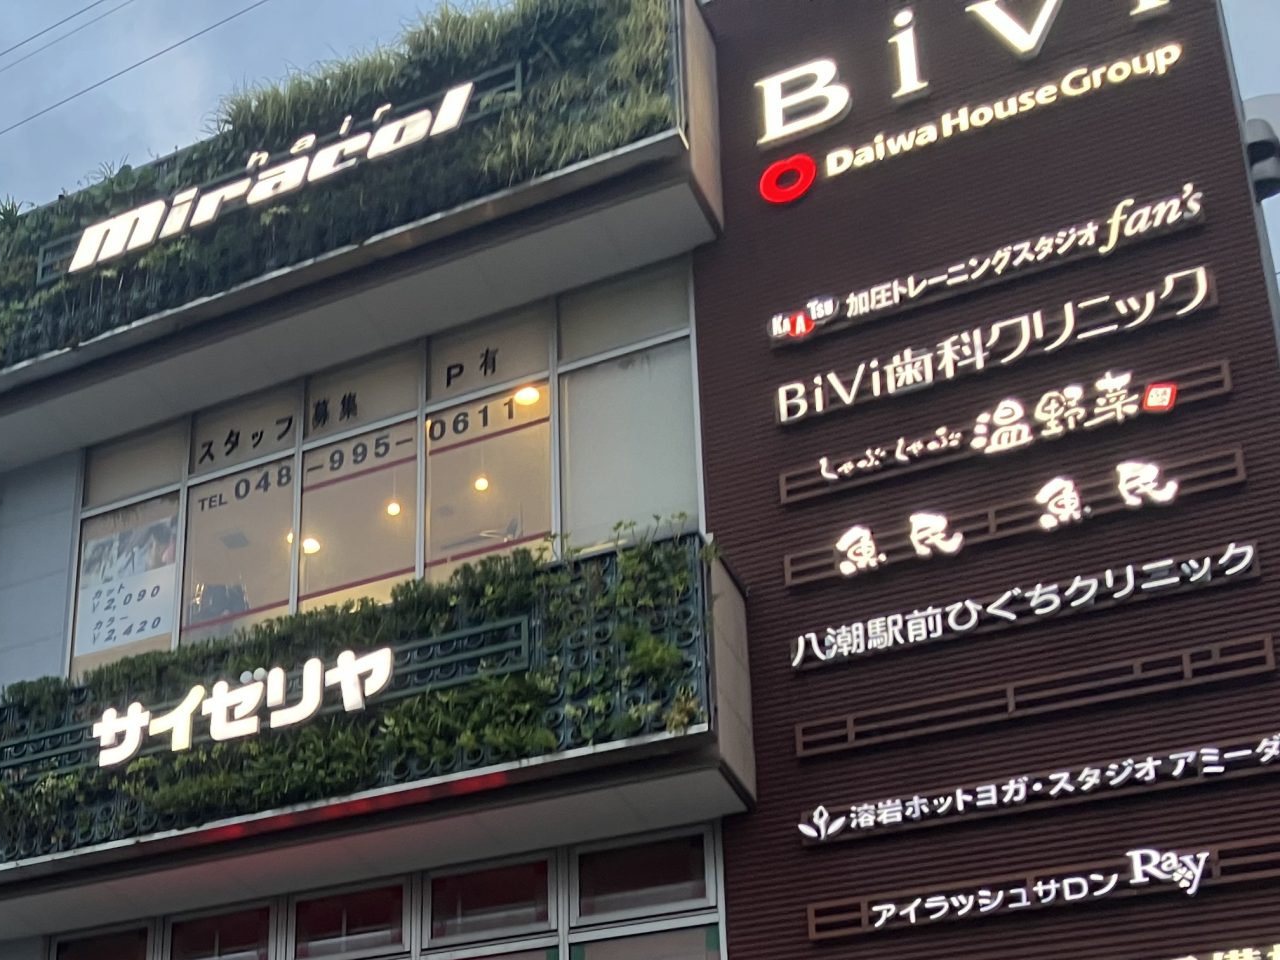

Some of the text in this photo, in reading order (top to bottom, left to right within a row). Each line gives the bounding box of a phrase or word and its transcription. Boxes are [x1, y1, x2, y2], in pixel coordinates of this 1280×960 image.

[755, 0, 1170, 146] BiV
[826, 41, 1183, 178] Daiwa House Group
[68, 81, 475, 273] miracol
[246, 103, 392, 172] hair
[846, 221, 1098, 319] 加圧トレーニングスタジオ
[1098, 183, 1204, 254] fan's
[777, 266, 1211, 424] BiVi歯科クリニック
[198, 396, 517, 512] TEL 048-995-0611
[200, 391, 358, 465] スタッフ募集
[819, 370, 1140, 480] しゃぶしゃぶ 温野菜
[835, 460, 1179, 575] 魚民 魚民
[791, 542, 1256, 668] 八潮駅前ひぐちクリニック
[93, 646, 395, 768] サイゼリヤ
[850, 733, 1280, 829] 溶岩ホットヨガ・スタジオ アミーダ
[871, 847, 1210, 928] アイラッシュサロン Ray
